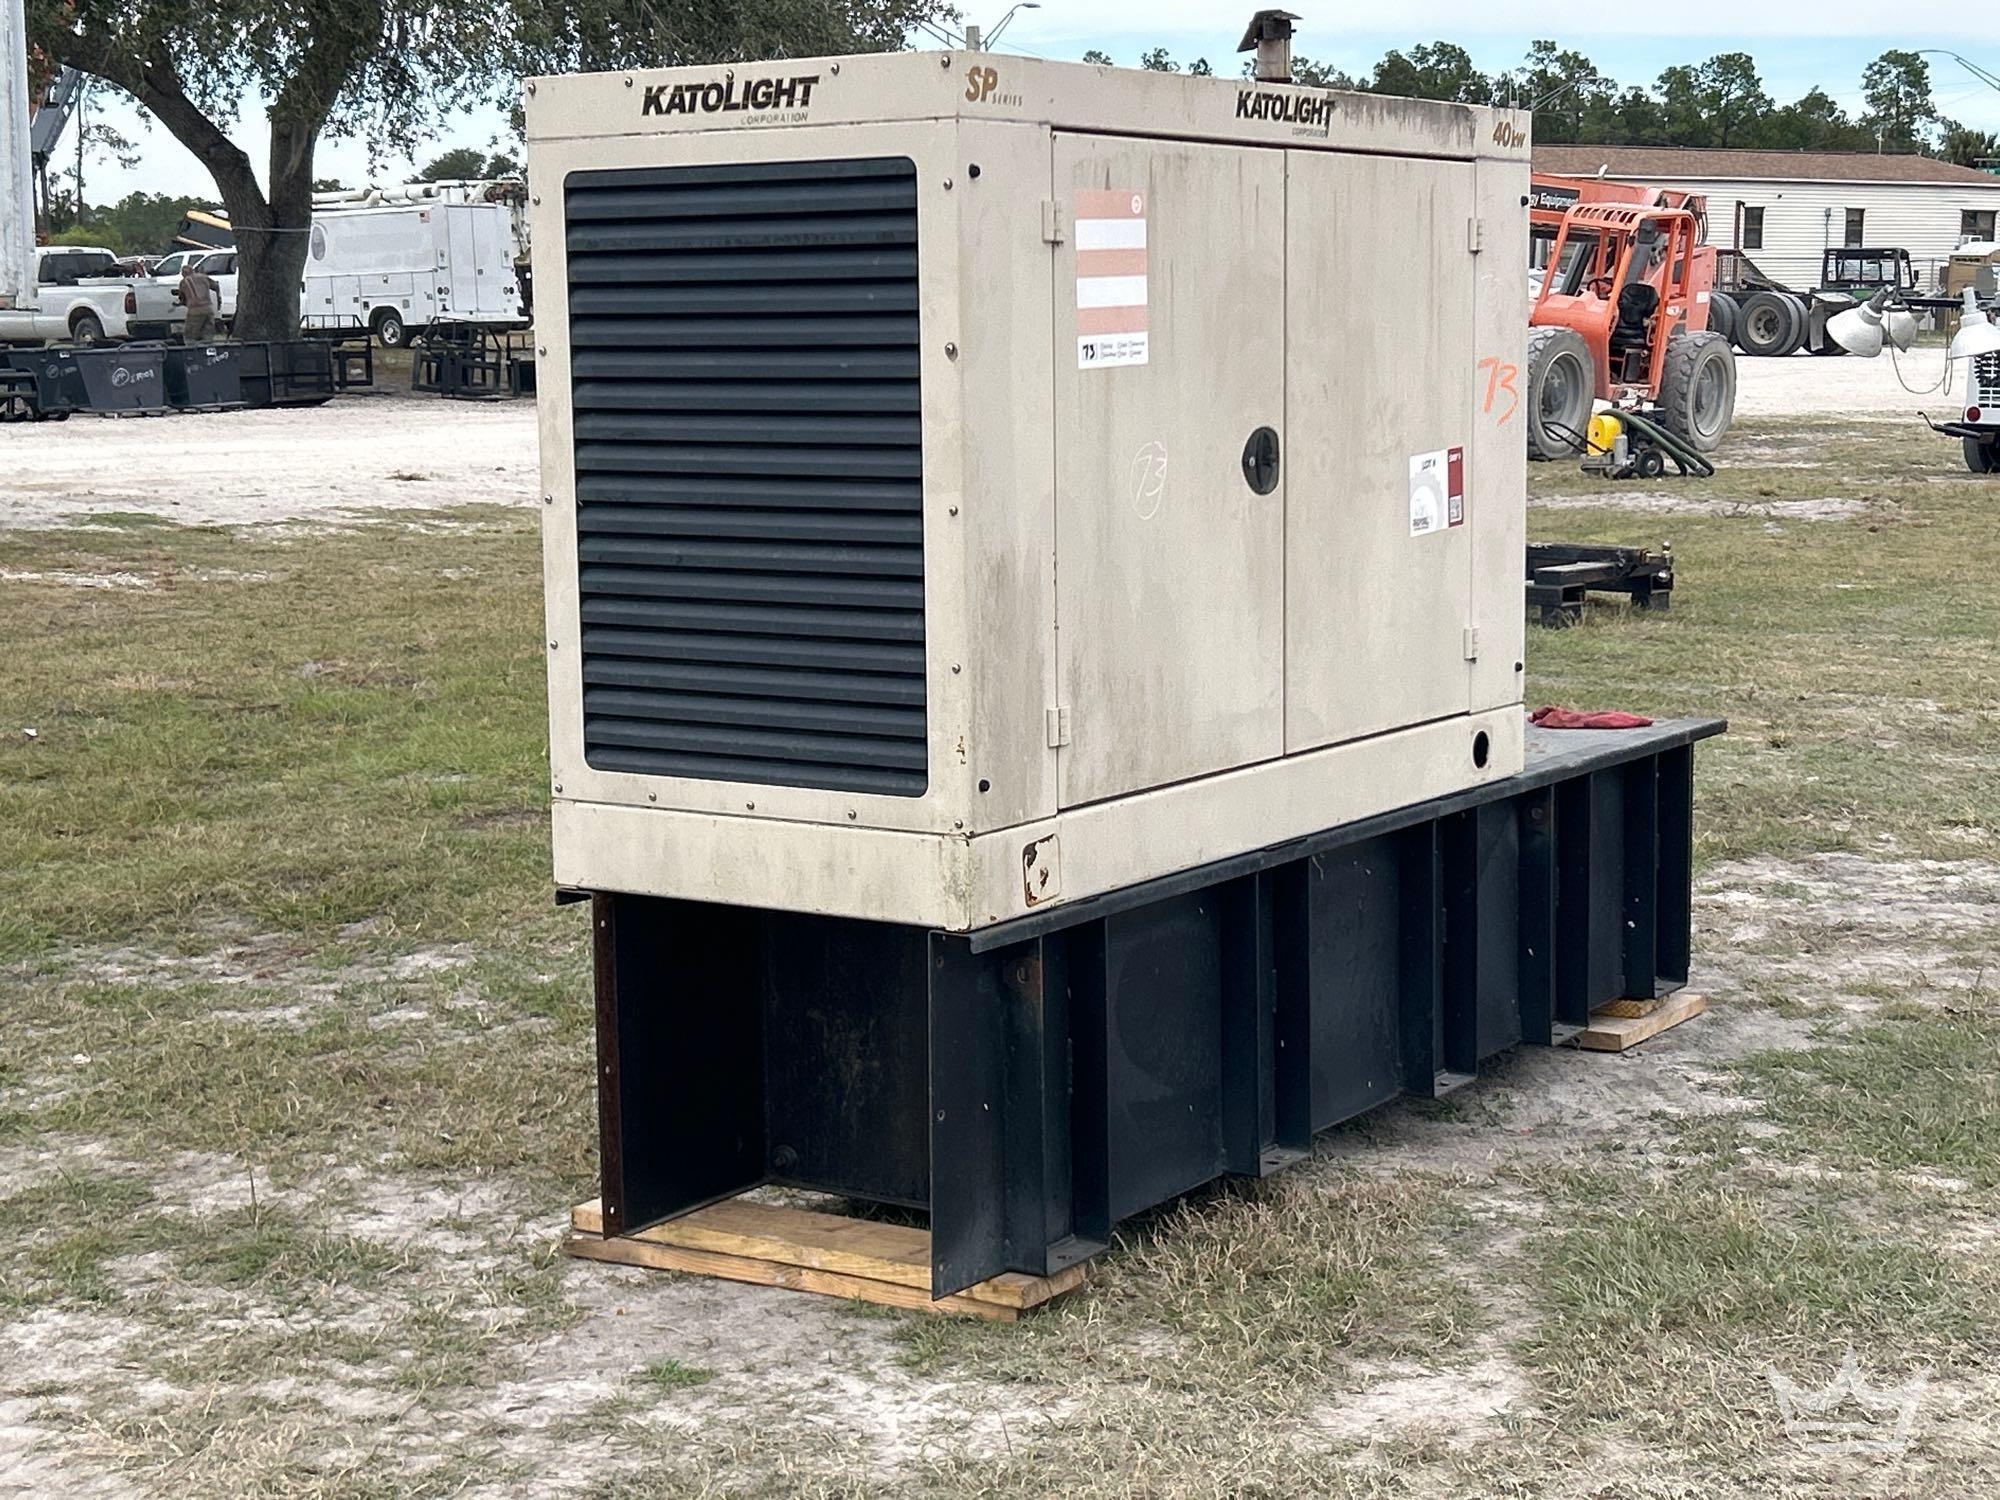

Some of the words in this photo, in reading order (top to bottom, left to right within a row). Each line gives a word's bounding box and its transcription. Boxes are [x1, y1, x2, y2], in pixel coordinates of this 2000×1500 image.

[641, 75, 820, 116] KATOLIGHT
[965, 66, 998, 103] SP
[741, 112, 809, 126] CORPORATION
[1235, 90, 1335, 130] KATOLIGHT
[1477, 356, 1519, 427] 73
[1135, 454, 1167, 503] 73
